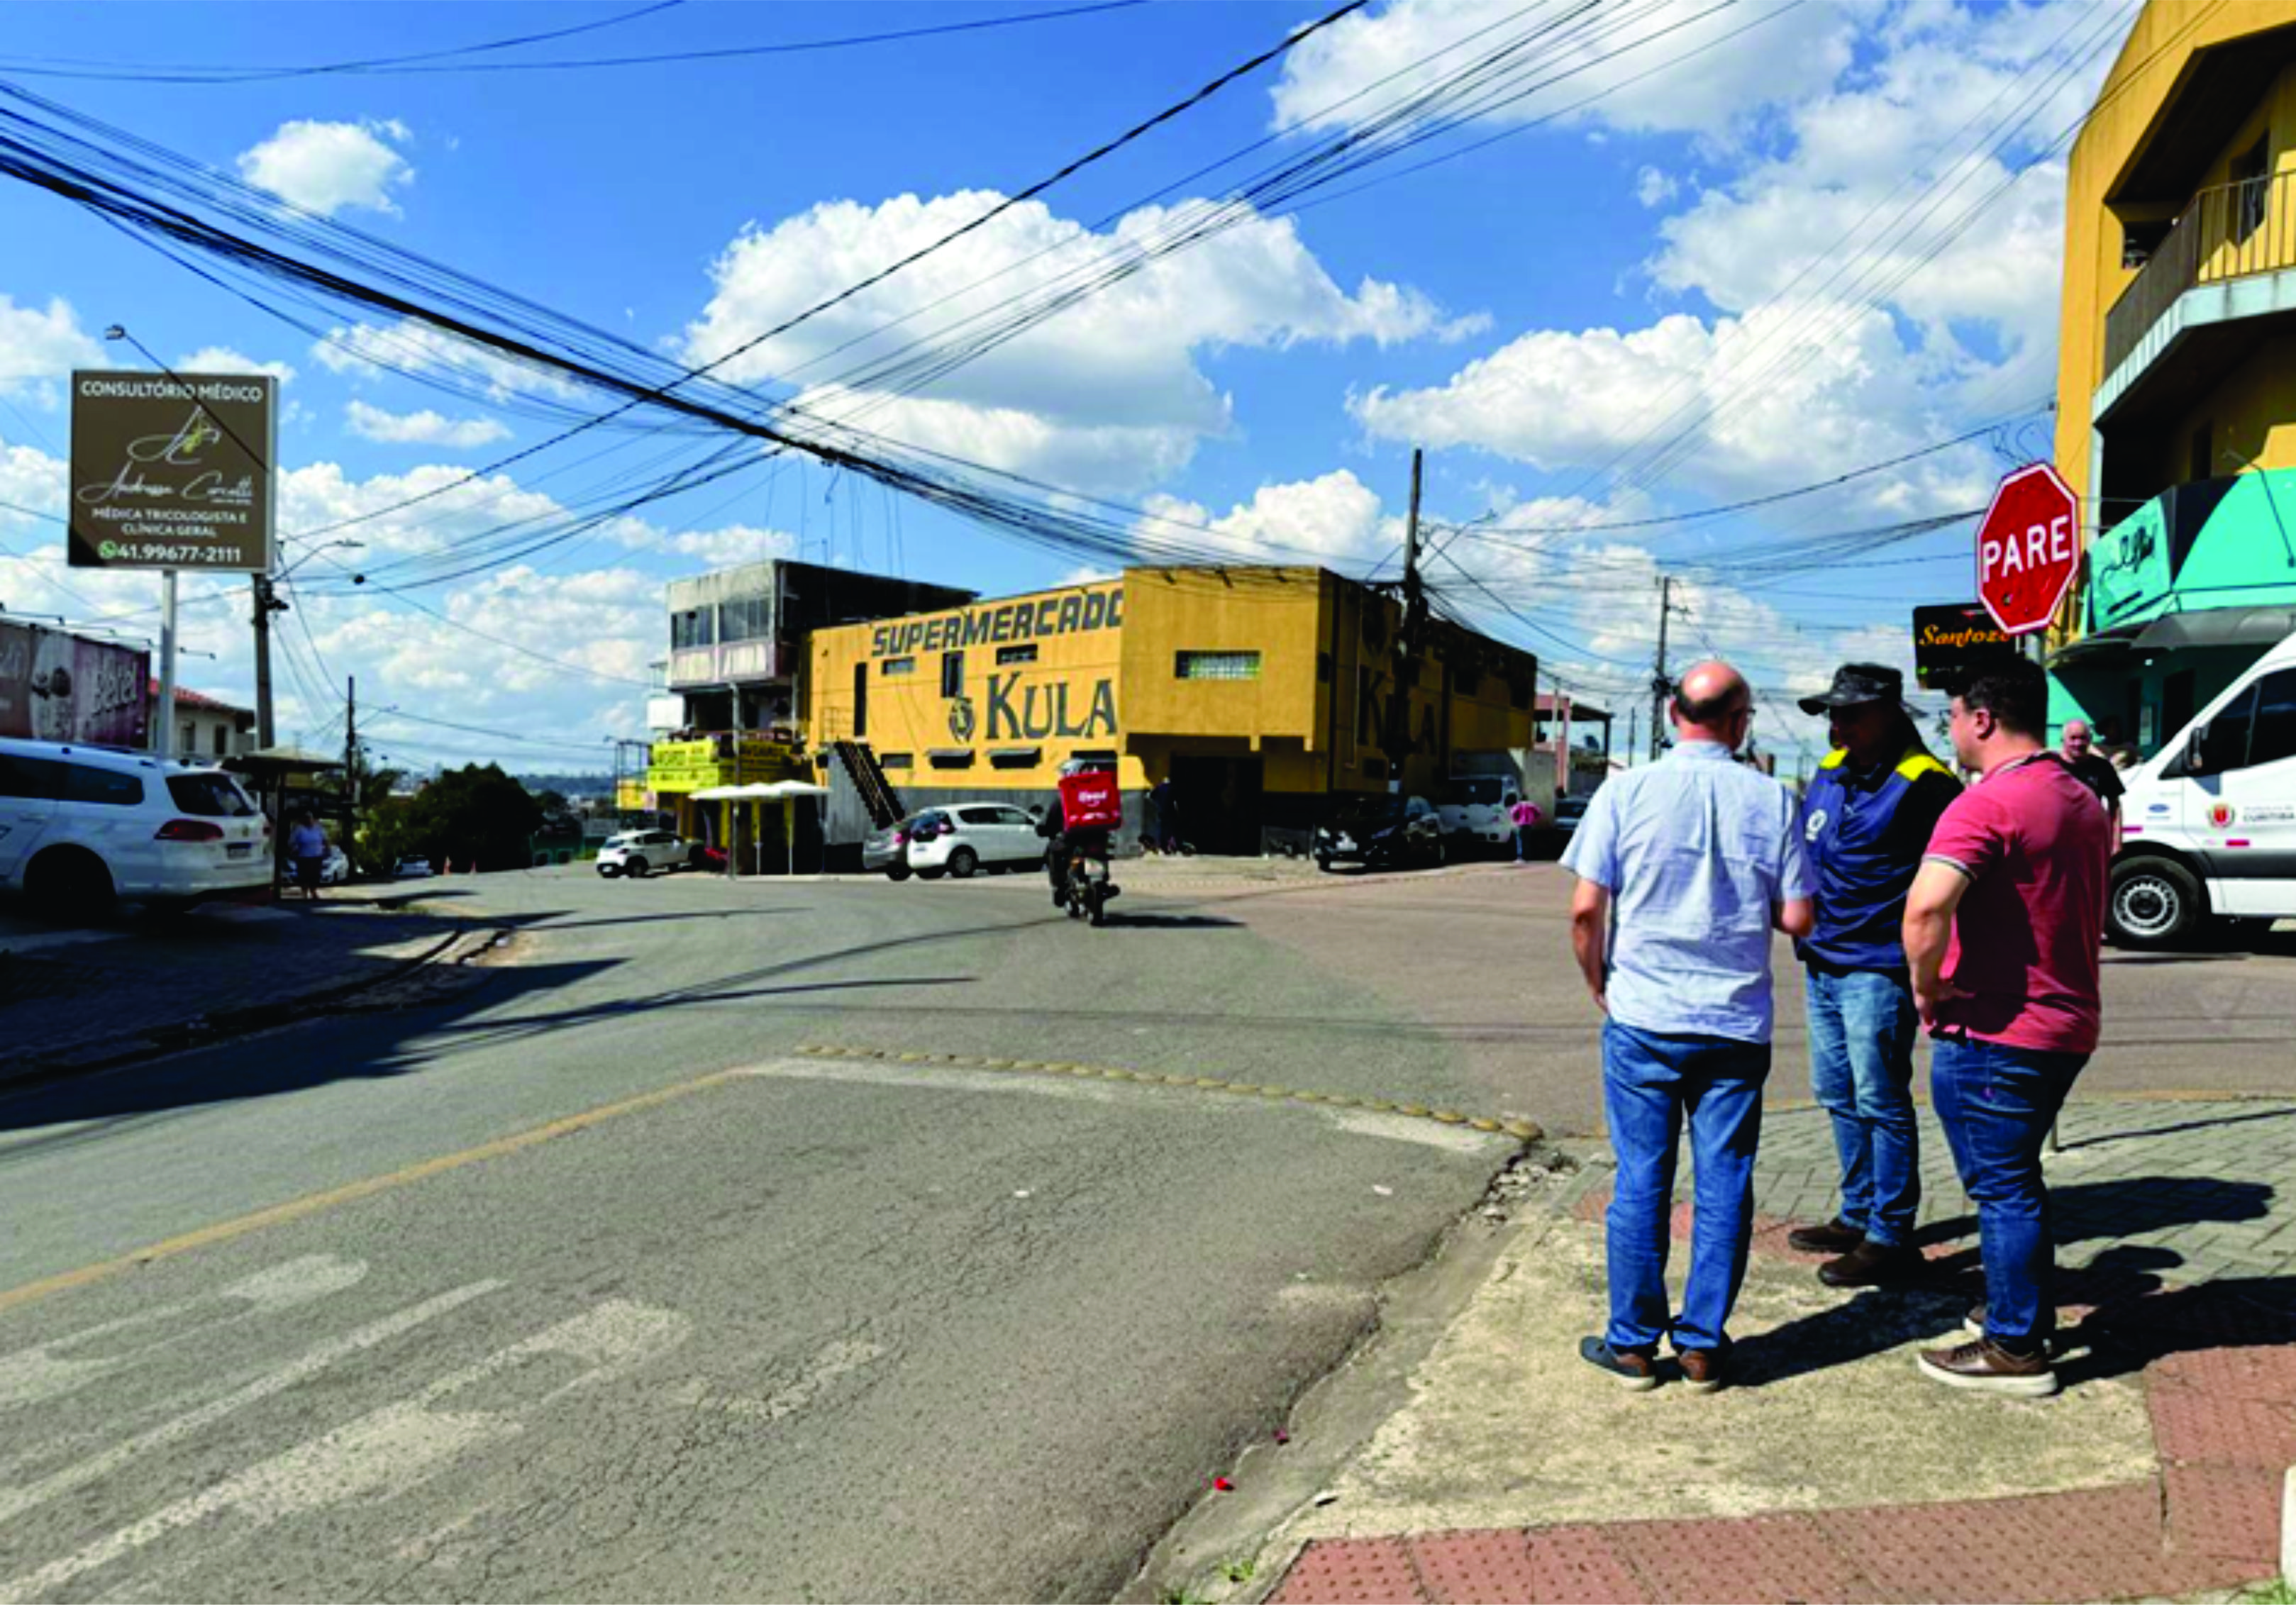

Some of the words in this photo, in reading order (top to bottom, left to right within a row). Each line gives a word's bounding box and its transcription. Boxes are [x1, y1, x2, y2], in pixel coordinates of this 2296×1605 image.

[82, 379, 195, 399] CONSULTÓRIO
[198, 382, 263, 402] MÉDICO
[91, 504, 142, 520] MÉDICA
[145, 506, 237, 523] TRICOLOGISTA
[238, 511, 247, 523] E
[121, 521, 174, 536] CLÍNICA
[176, 524, 218, 538] GERAL
[117, 543, 242, 562] 41.99677-2111
[1982, 515, 2071, 583] PARE
